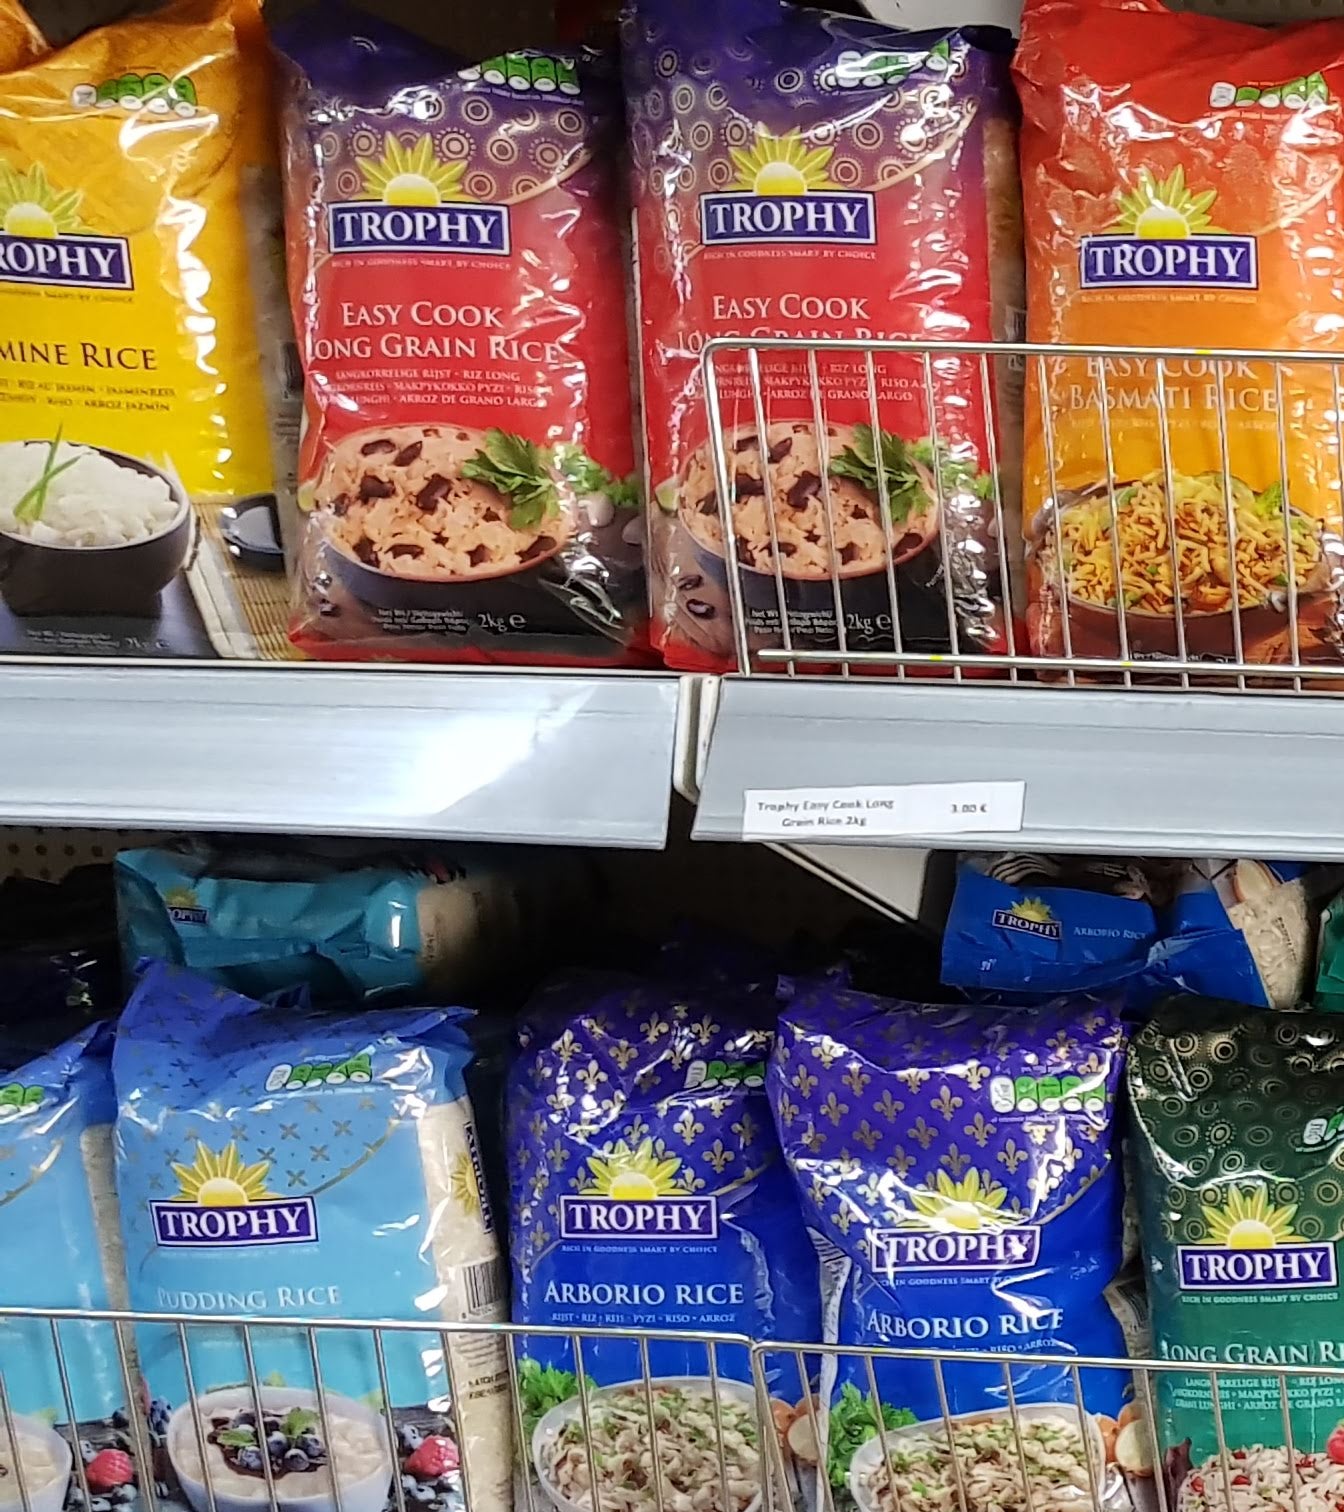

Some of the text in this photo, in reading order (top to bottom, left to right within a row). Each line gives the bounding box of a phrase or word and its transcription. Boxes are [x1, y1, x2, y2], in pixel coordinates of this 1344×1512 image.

[337, 206, 502, 246] TROPHY
[711, 201, 861, 235] TROPHY
[1089, 241, 1248, 281] TROPHY
[341, 302, 503, 328] EASY COOK
[713, 293, 870, 320] EASY COOK
[160, 1203, 306, 1238] TROPHY
[569, 1203, 706, 1231] TROPHY
[885, 1234, 1031, 1262] TROPHY
[1186, 1252, 1326, 1281] TROPHY
[158, 1285, 339, 1309] PUDDING RICE
[545, 1283, 744, 1306] ARBORIO RICE
[868, 1309, 1064, 1338] ARBORIO RICE
